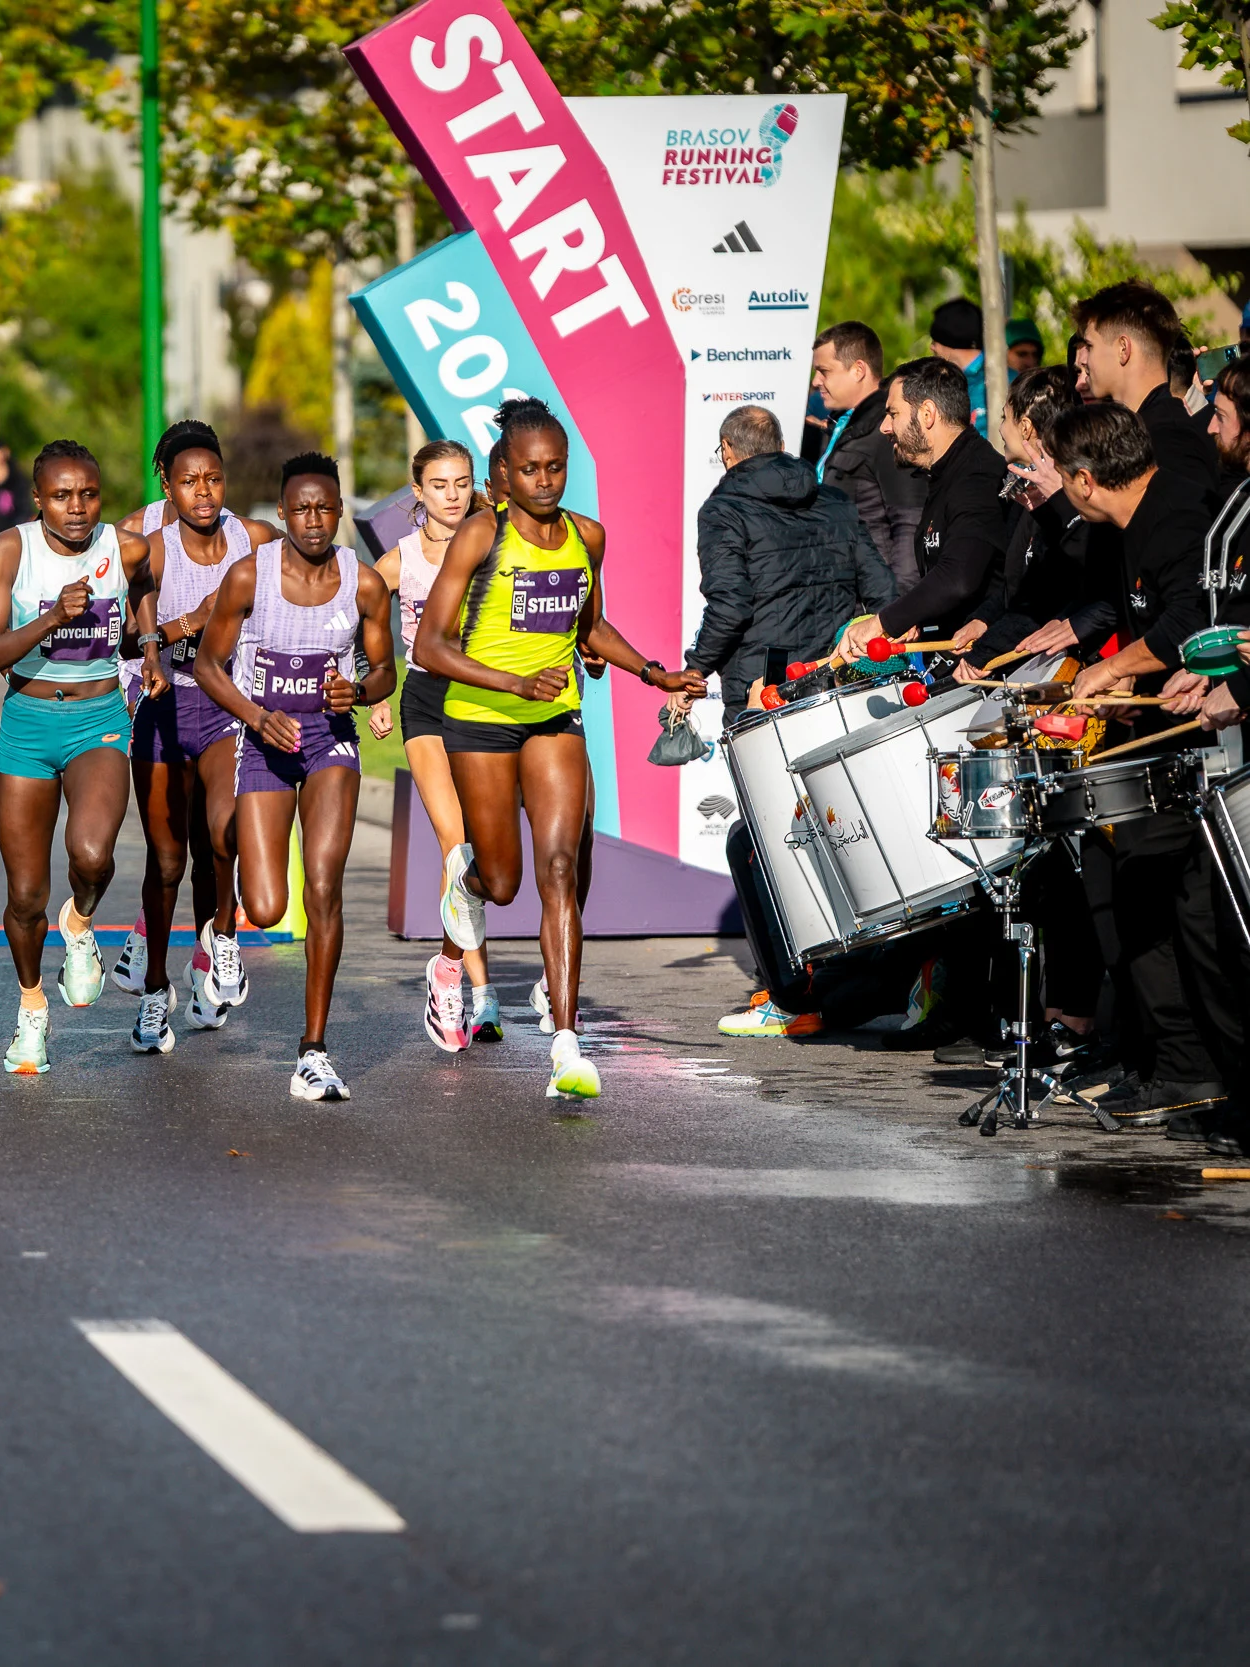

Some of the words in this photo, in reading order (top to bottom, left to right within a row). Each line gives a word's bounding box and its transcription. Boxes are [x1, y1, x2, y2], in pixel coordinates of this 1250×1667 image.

[666, 128, 751, 146] BRASOV
[664, 147, 772, 166] RUNNING
[410, 13, 650, 339] START
[662, 167, 764, 185] FESTIVAL
[748, 288, 809, 303] Autoliv
[707, 347, 792, 362] Benchmark
[404, 281, 531, 457] 202
[712, 391, 776, 402] INTERSPORT
[527, 595, 578, 614] STELLA
[53, 626, 108, 639] JOYCILINE
[271, 676, 318, 695] PACE
